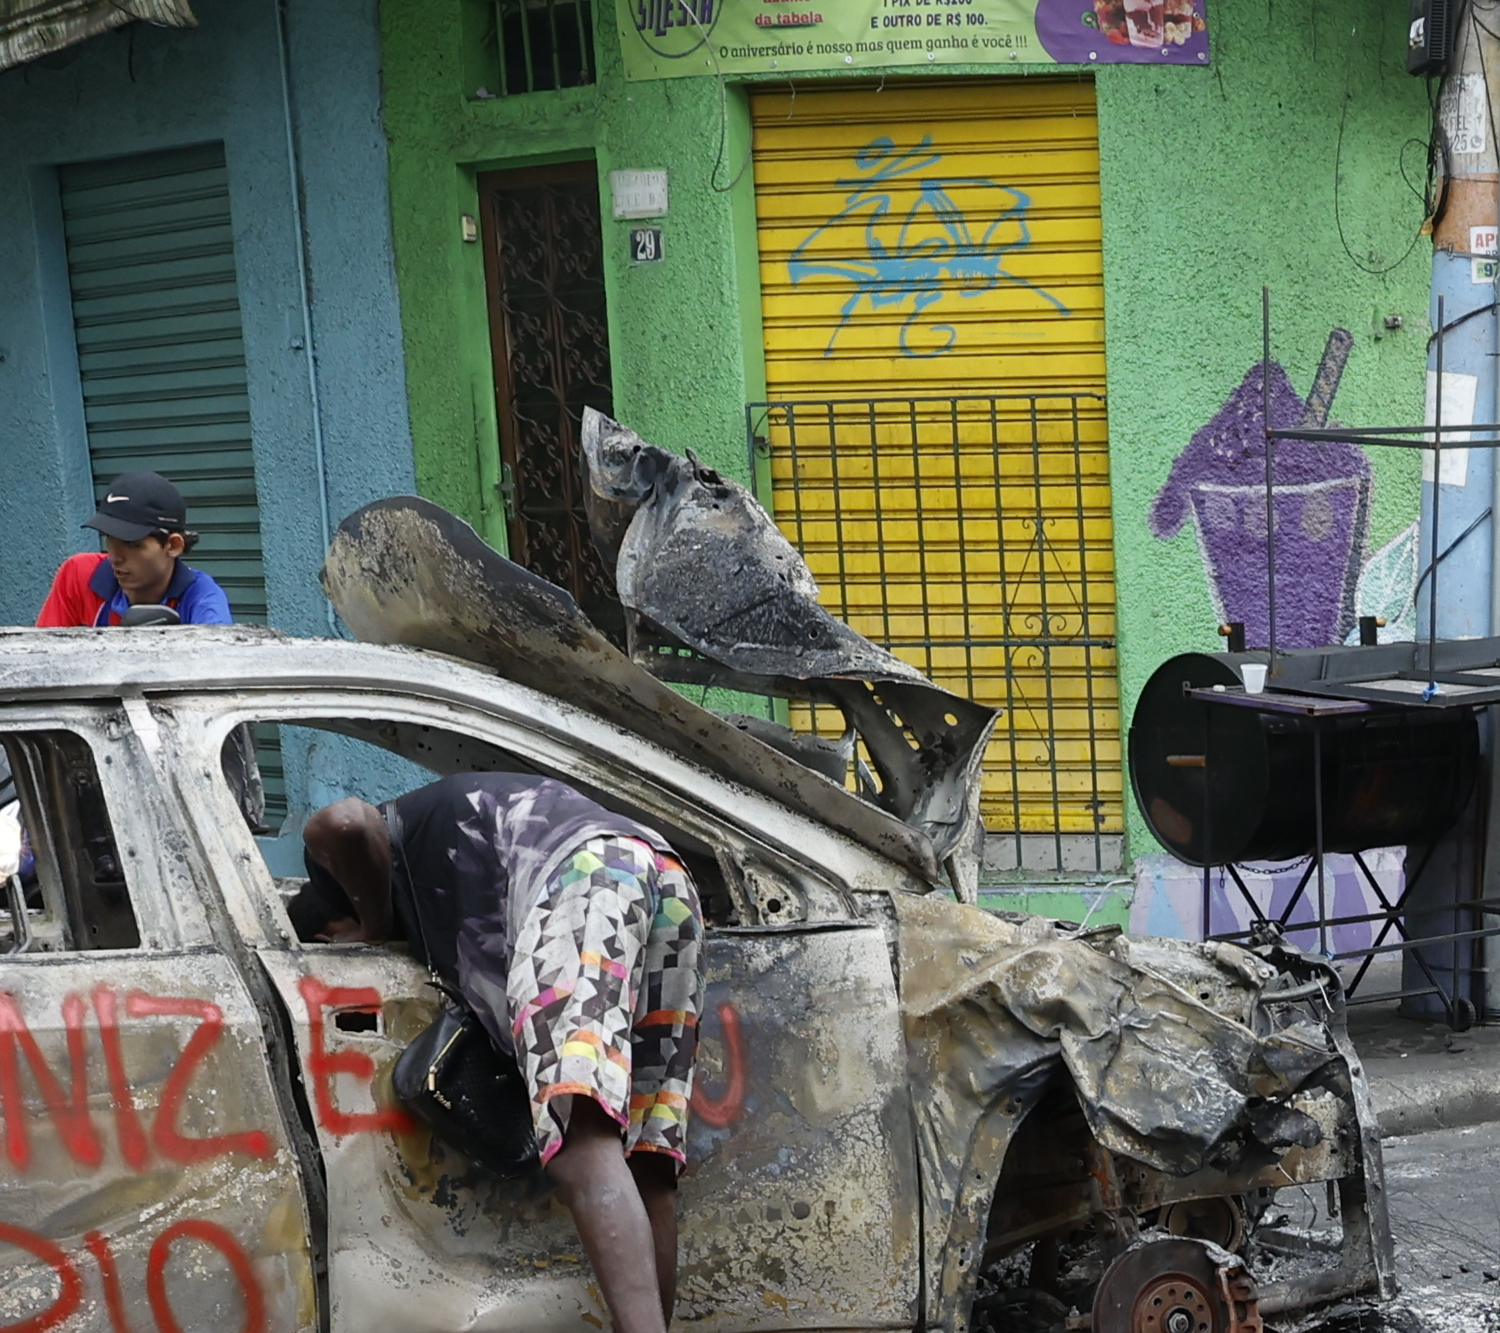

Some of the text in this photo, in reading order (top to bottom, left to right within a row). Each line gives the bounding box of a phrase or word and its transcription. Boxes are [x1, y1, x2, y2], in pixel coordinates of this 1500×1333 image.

[755, 11, 823, 26] da tabela
[870, 11, 988, 28] E OUTRO DE R$ 100.
[719, 45, 728, 59] O
[731, 41, 804, 58] aniversário
[806, 41, 814, 55] é
[816, 42, 853, 55] nosso
[855, 40, 884, 53] mas
[886, 39, 923, 54] quem
[926, 35, 969, 51] ganha
[972, 34, 979, 48] é
[981, 33, 1013, 48] você
[636, 230, 656, 260] 29
